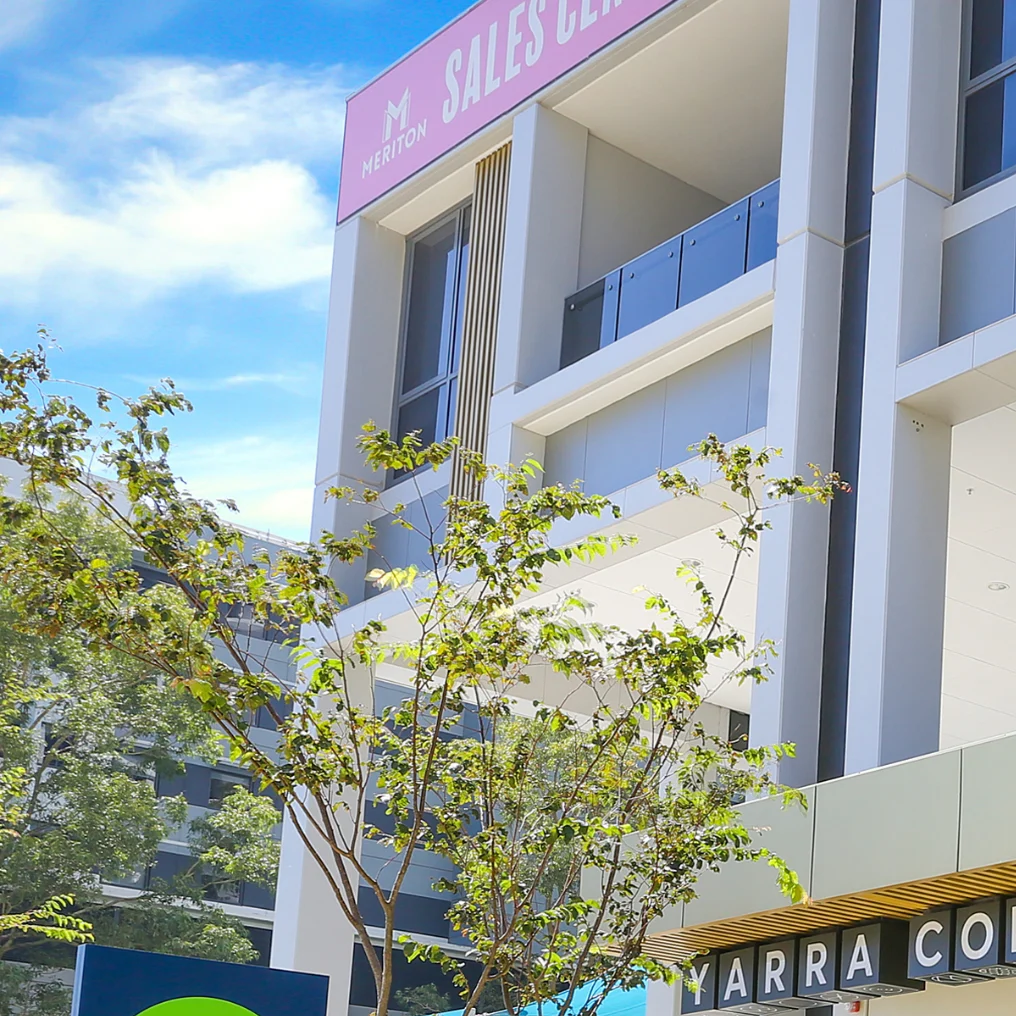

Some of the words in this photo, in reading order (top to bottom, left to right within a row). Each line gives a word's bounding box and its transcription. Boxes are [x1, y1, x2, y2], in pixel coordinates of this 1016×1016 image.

[442, 0, 546, 124] SALES
[362, 118, 427, 179] MERITON
[690, 934, 873, 1005] YARRA
